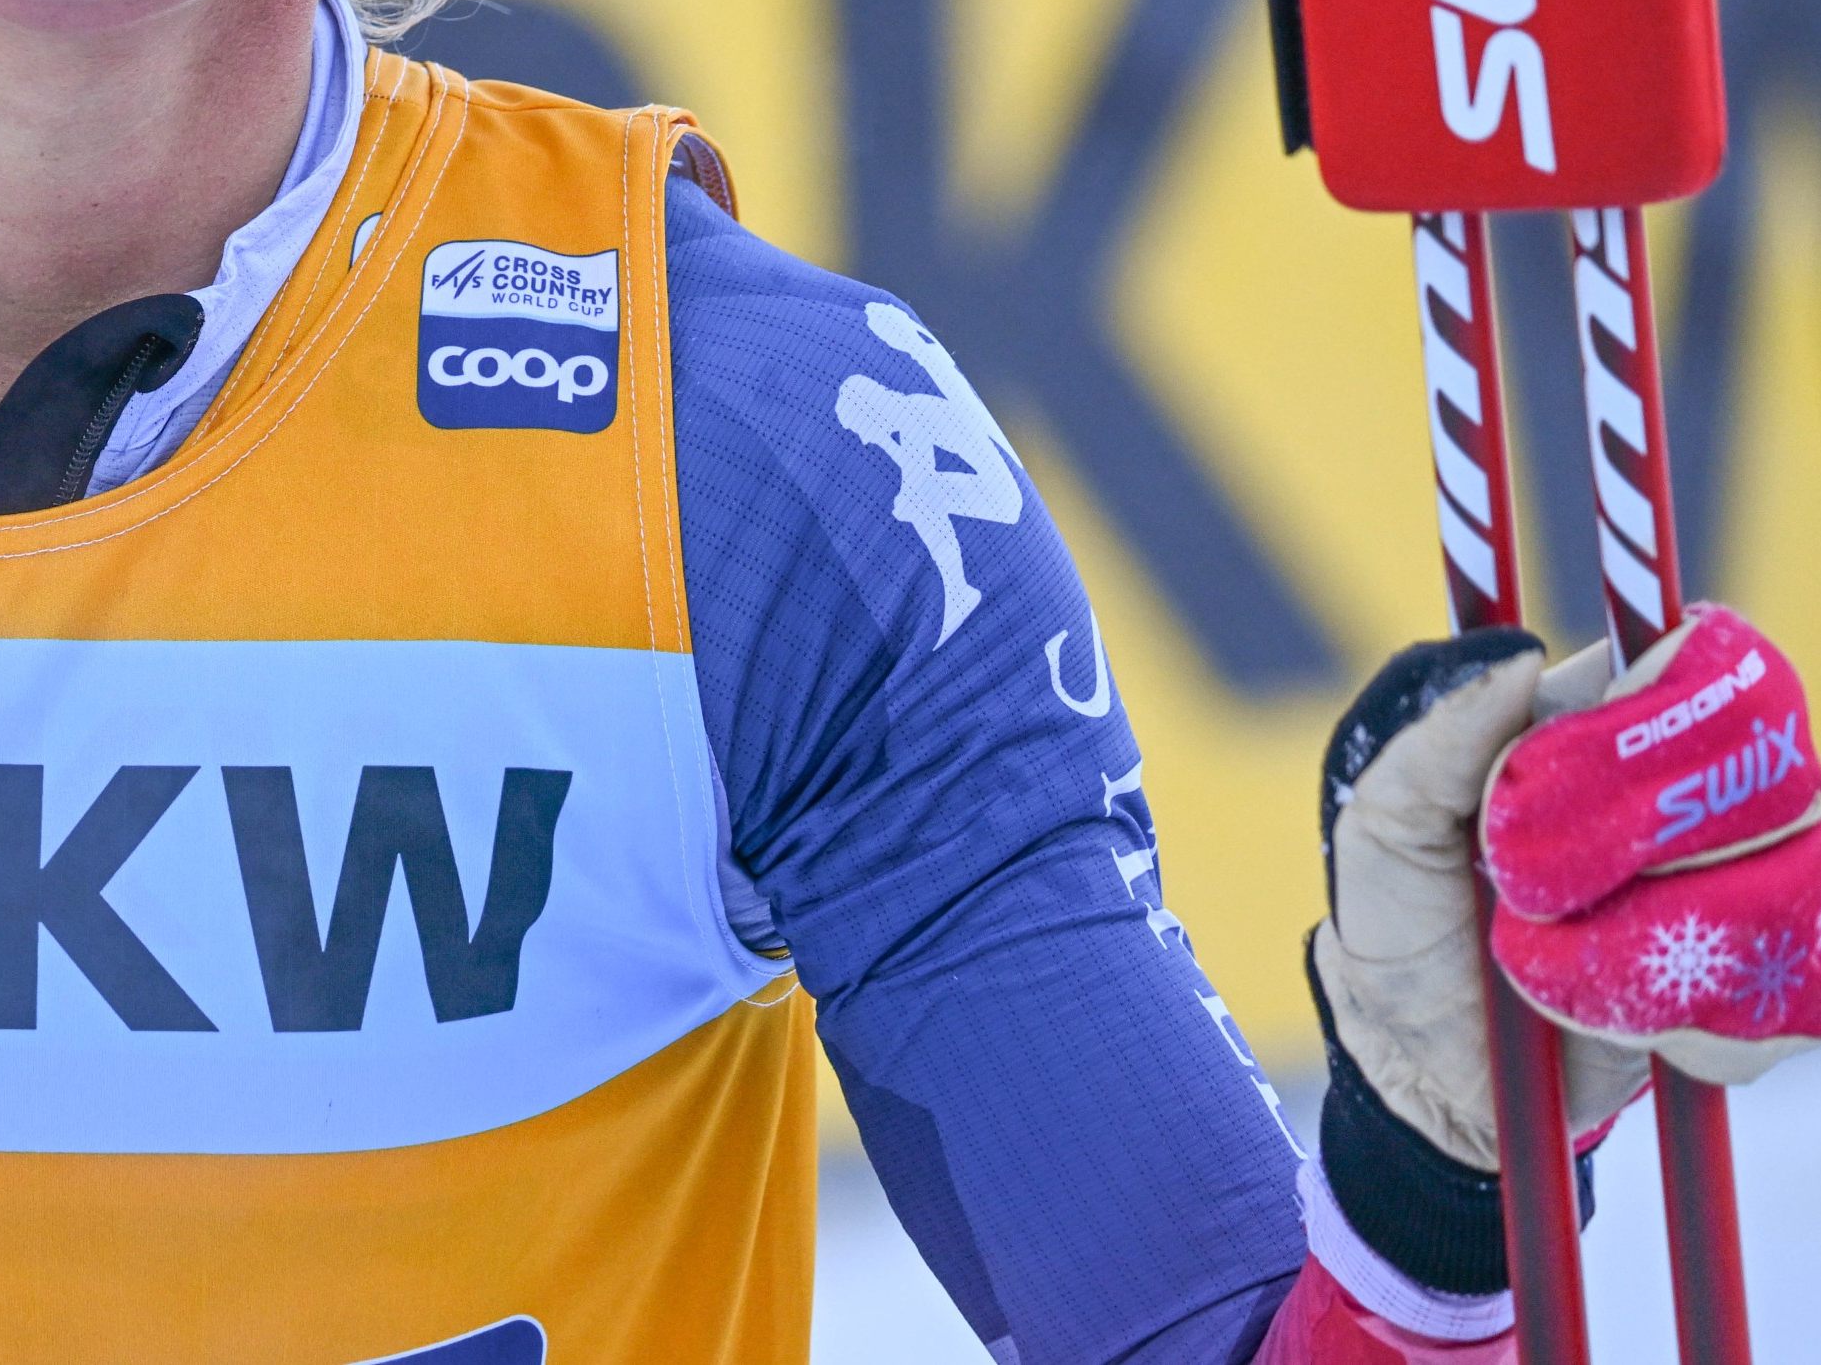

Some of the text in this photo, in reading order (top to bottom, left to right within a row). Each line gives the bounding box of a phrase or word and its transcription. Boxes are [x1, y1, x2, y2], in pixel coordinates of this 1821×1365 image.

[493, 255, 581, 286] CROSS
[492, 273, 612, 306] COUNTRY
[492, 292, 604, 317] WORLD CUP
[427, 345, 609, 404] coop
[1616, 648, 1768, 760] DIGGINS
